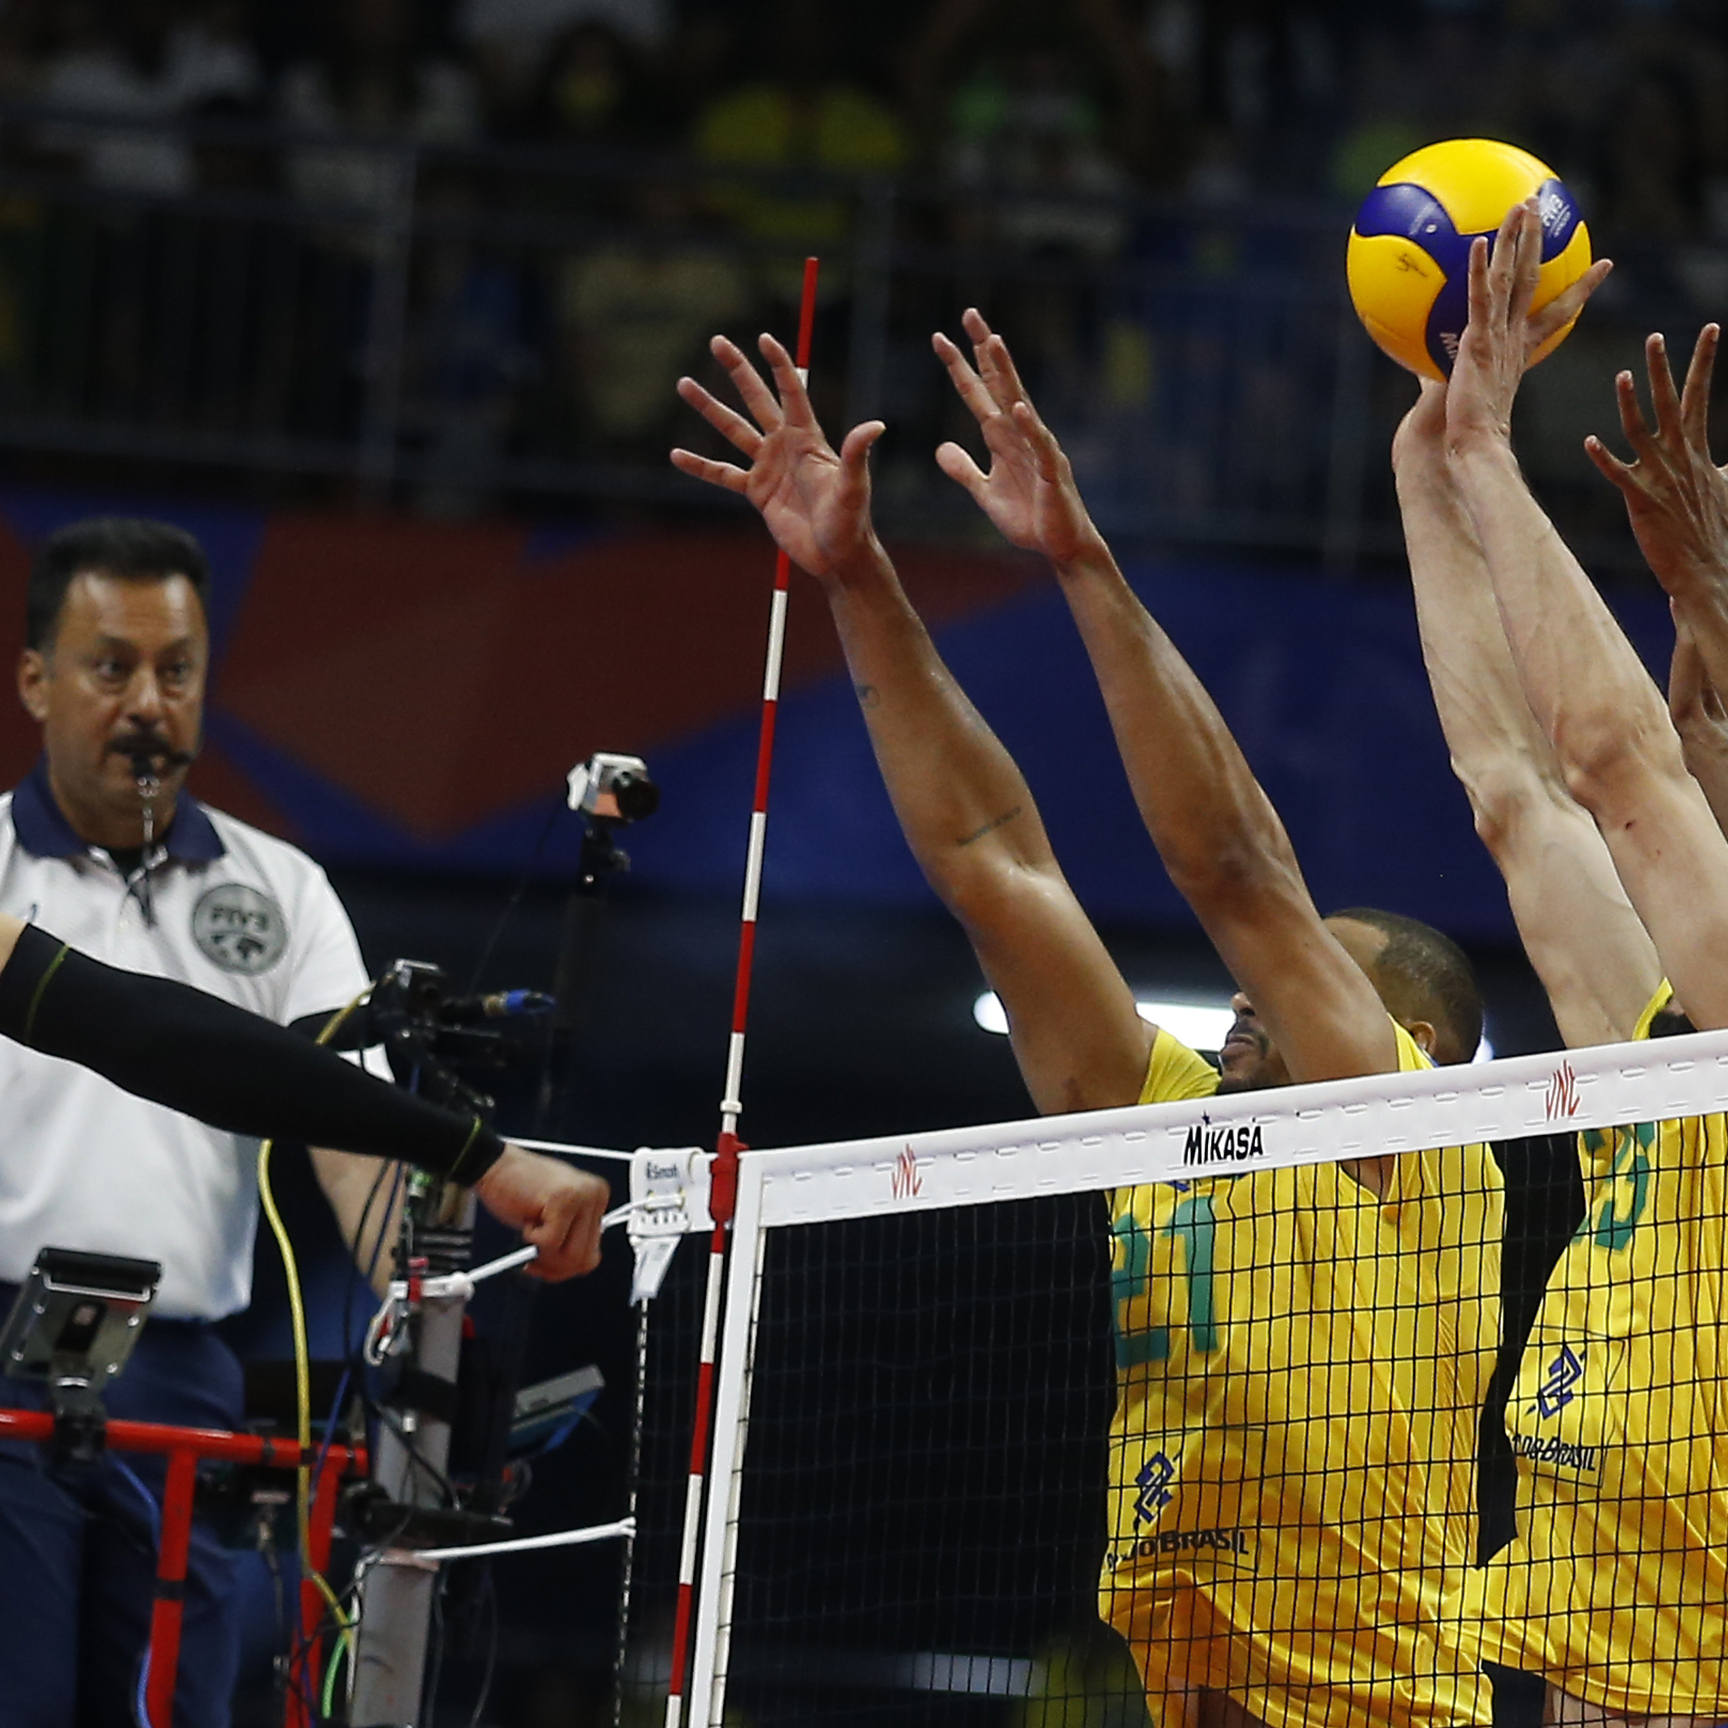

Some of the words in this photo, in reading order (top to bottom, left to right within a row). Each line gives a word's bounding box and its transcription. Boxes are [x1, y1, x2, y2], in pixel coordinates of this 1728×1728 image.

[1544, 1058, 1580, 1122] VNL
[891, 1143, 924, 1200] VNL
[1111, 1196, 1218, 1369] 21
